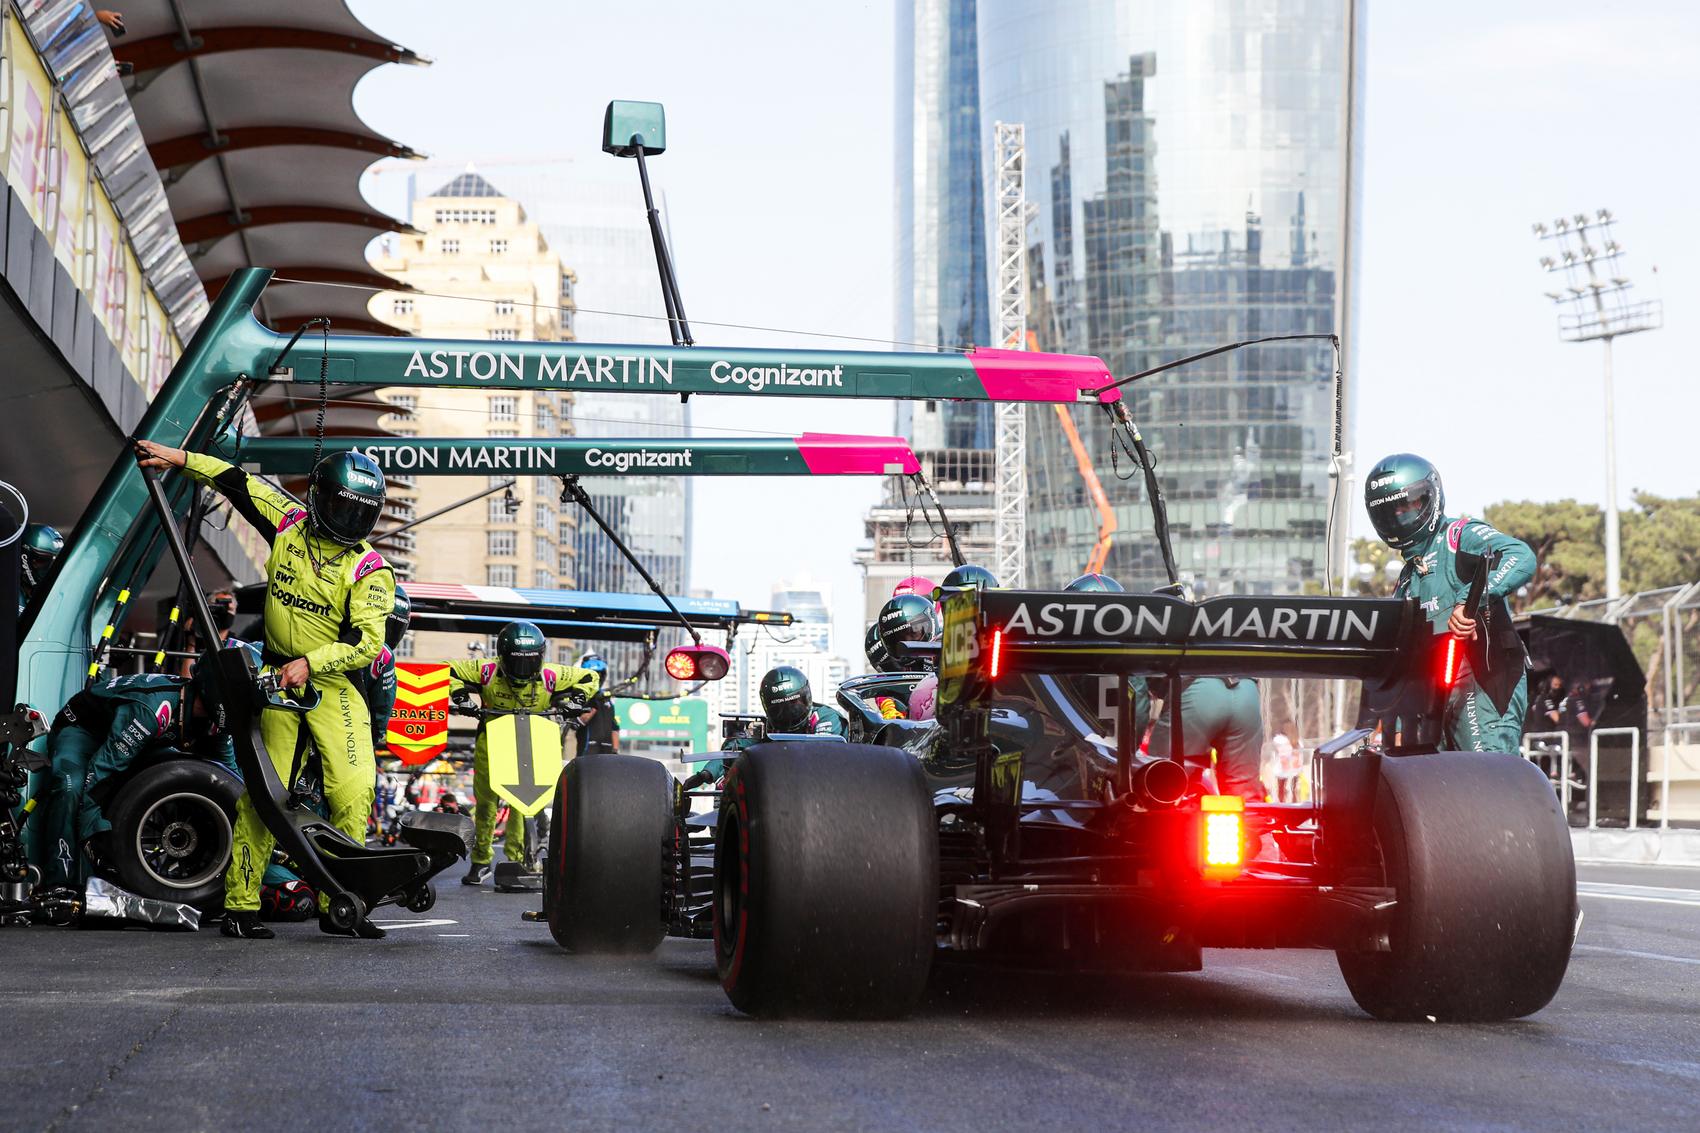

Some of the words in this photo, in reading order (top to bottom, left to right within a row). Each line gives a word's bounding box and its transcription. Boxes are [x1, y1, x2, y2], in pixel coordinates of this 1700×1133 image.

[404, 351, 524, 380] ASTON
[537, 354, 673, 384] MARTIN
[710, 360, 844, 392] Cognizant
[351, 446, 440, 470] STON
[448, 446, 556, 470] MARTIN
[584, 449, 692, 472] Cognizant
[358, 476, 377, 489] BWT
[338, 490, 358, 501] ASTON
[359, 496, 379, 507] MARTIN
[1385, 491, 1409, 503] MARTIN
[275, 570, 295, 586] BWT
[1493, 556, 1519, 583] MARTIN
[271, 582, 333, 617] Cognizant
[887, 610, 903, 621] BWT
[1002, 603, 1172, 636] ASTON
[1189, 606, 1380, 642] MARTIN
[893, 622, 912, 634] MARTIN
[521, 638, 535, 646] BWT
[870, 640, 882, 654] BWT
[945, 621, 980, 665] JCB
[322, 657, 346, 672] ASTON
[346, 641, 373, 662] MARTIN
[778, 682, 793, 692] BWT
[339, 687, 353, 728] MARTIN
[390, 709, 446, 720] BRAKES
[1466, 692, 1480, 736] MARTIN
[405, 725, 425, 734] ON
[345, 731, 357, 766] ASTON
